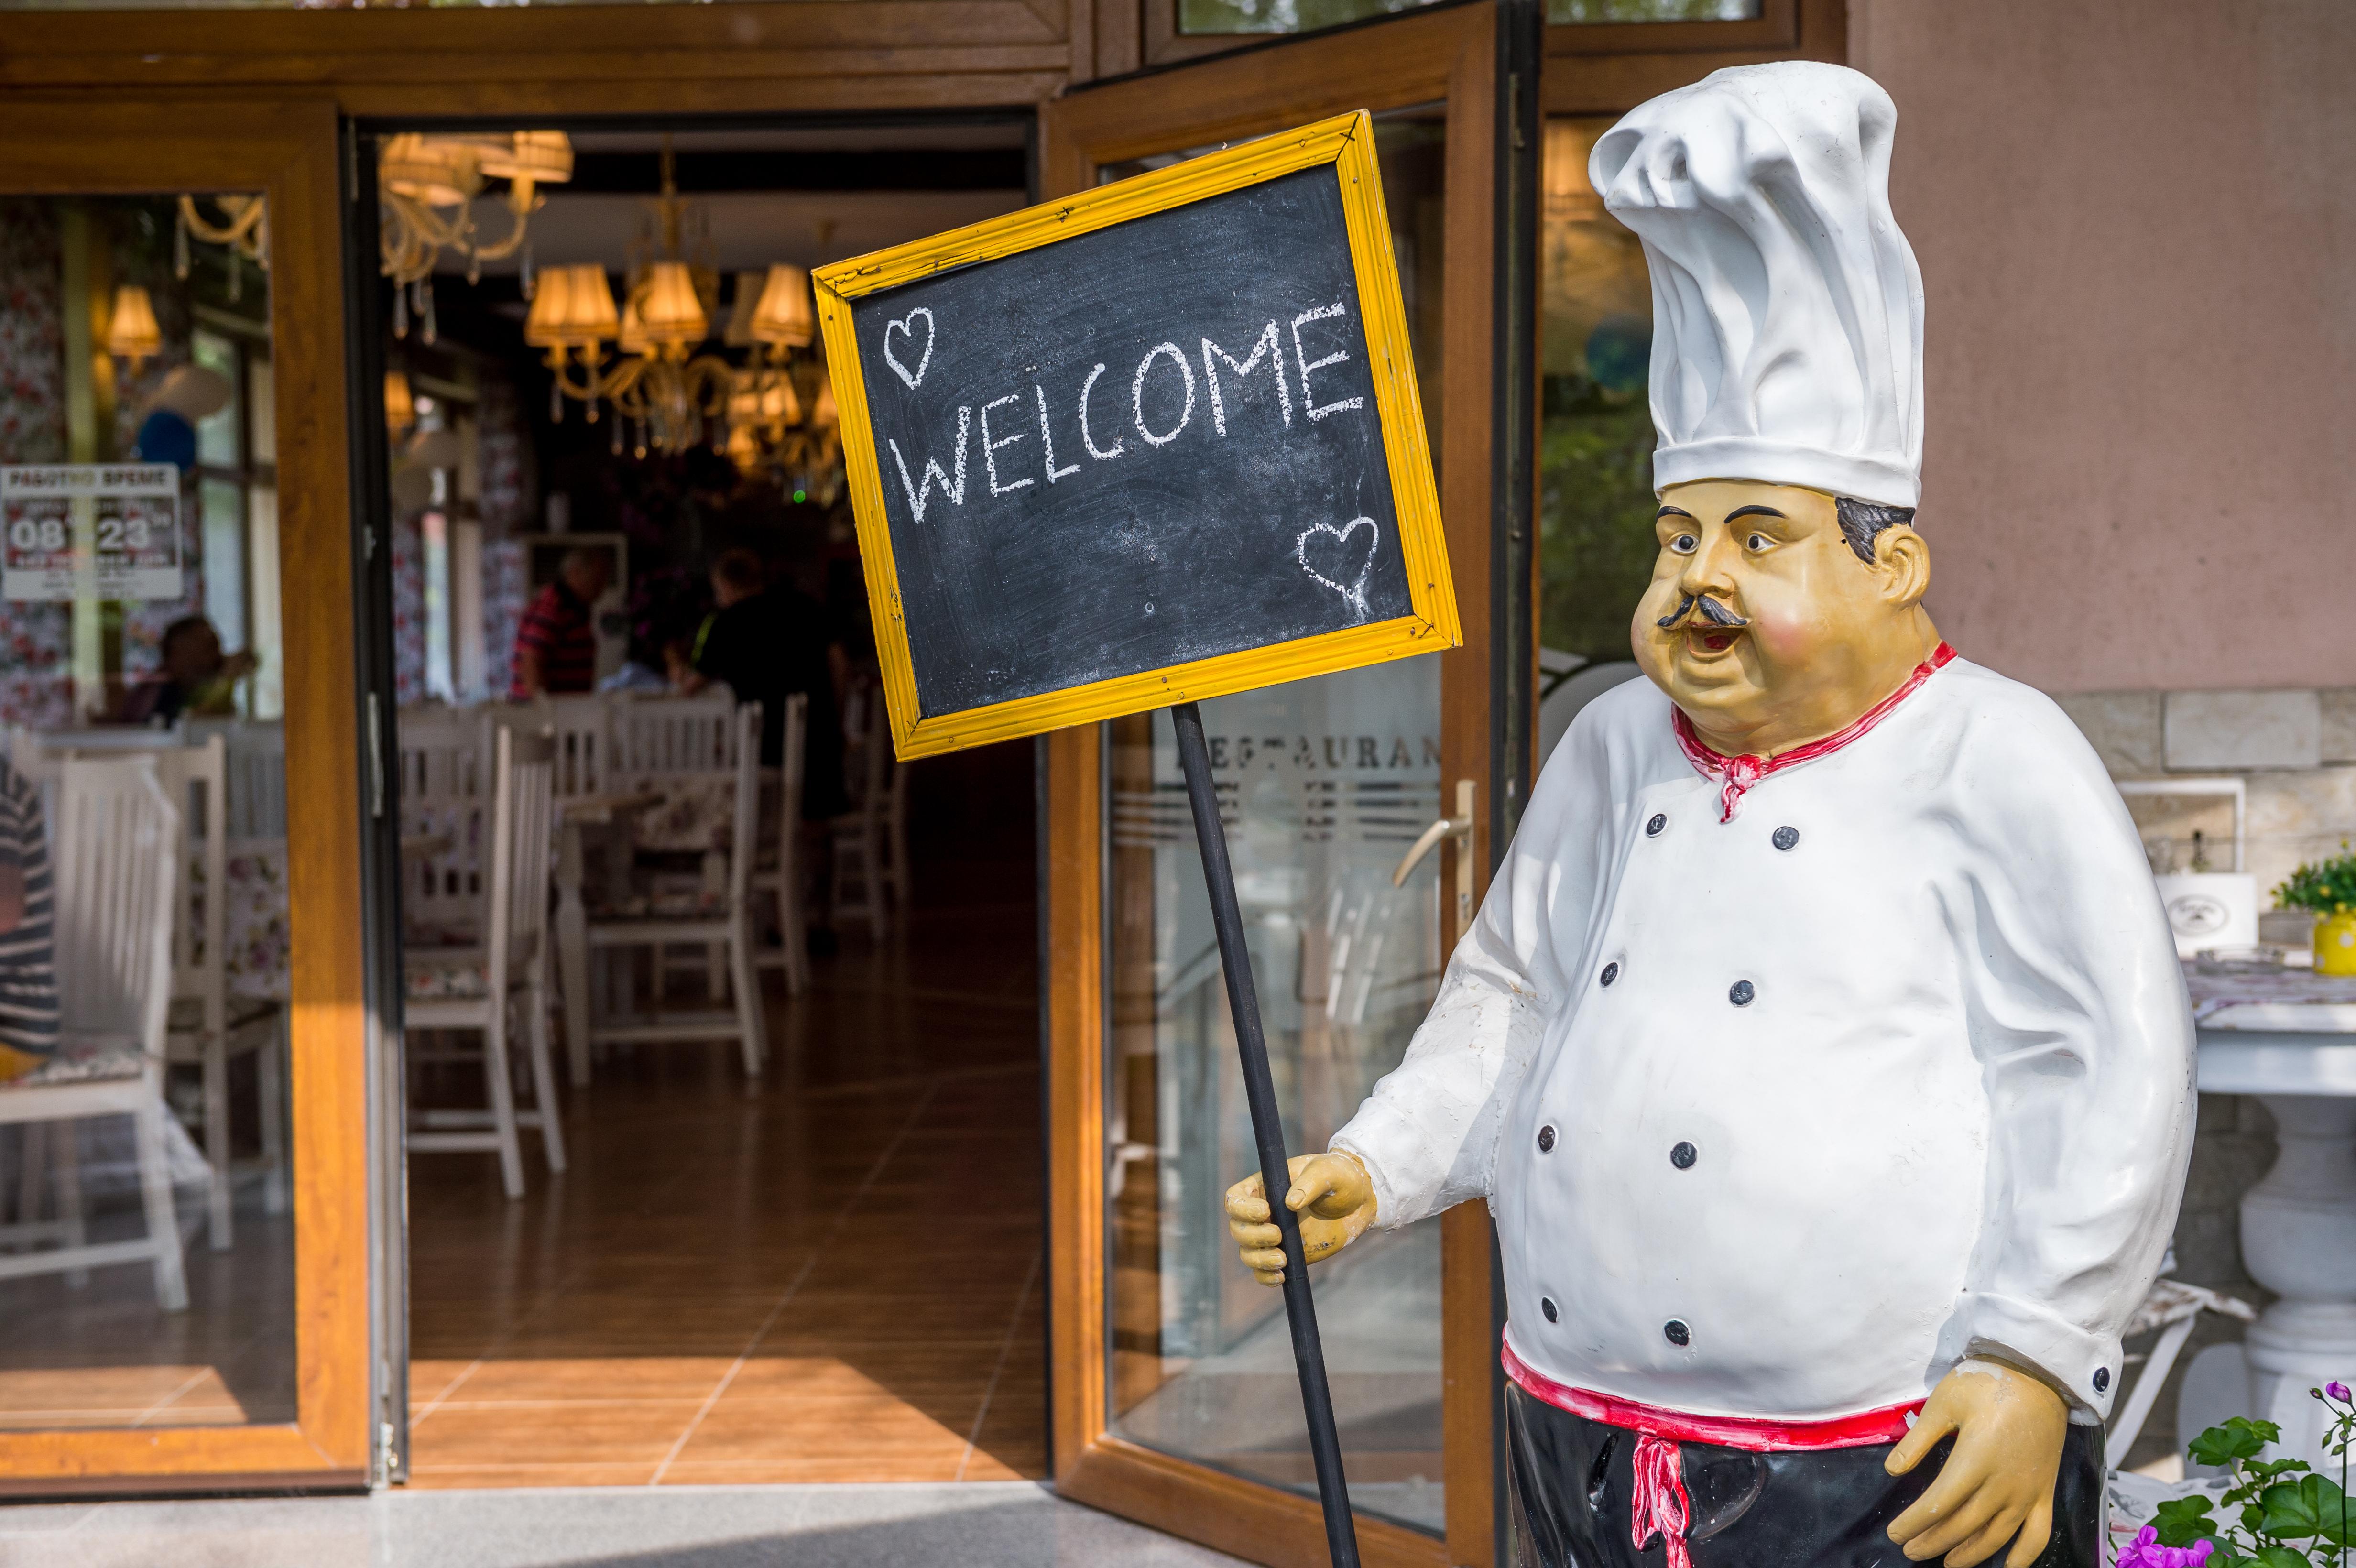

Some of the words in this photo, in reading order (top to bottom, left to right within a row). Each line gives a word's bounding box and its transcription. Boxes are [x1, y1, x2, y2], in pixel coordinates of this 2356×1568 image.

[889, 302, 1364, 524] WELCOME
[11, 517, 65, 551] 08
[99, 516, 150, 550] 23
